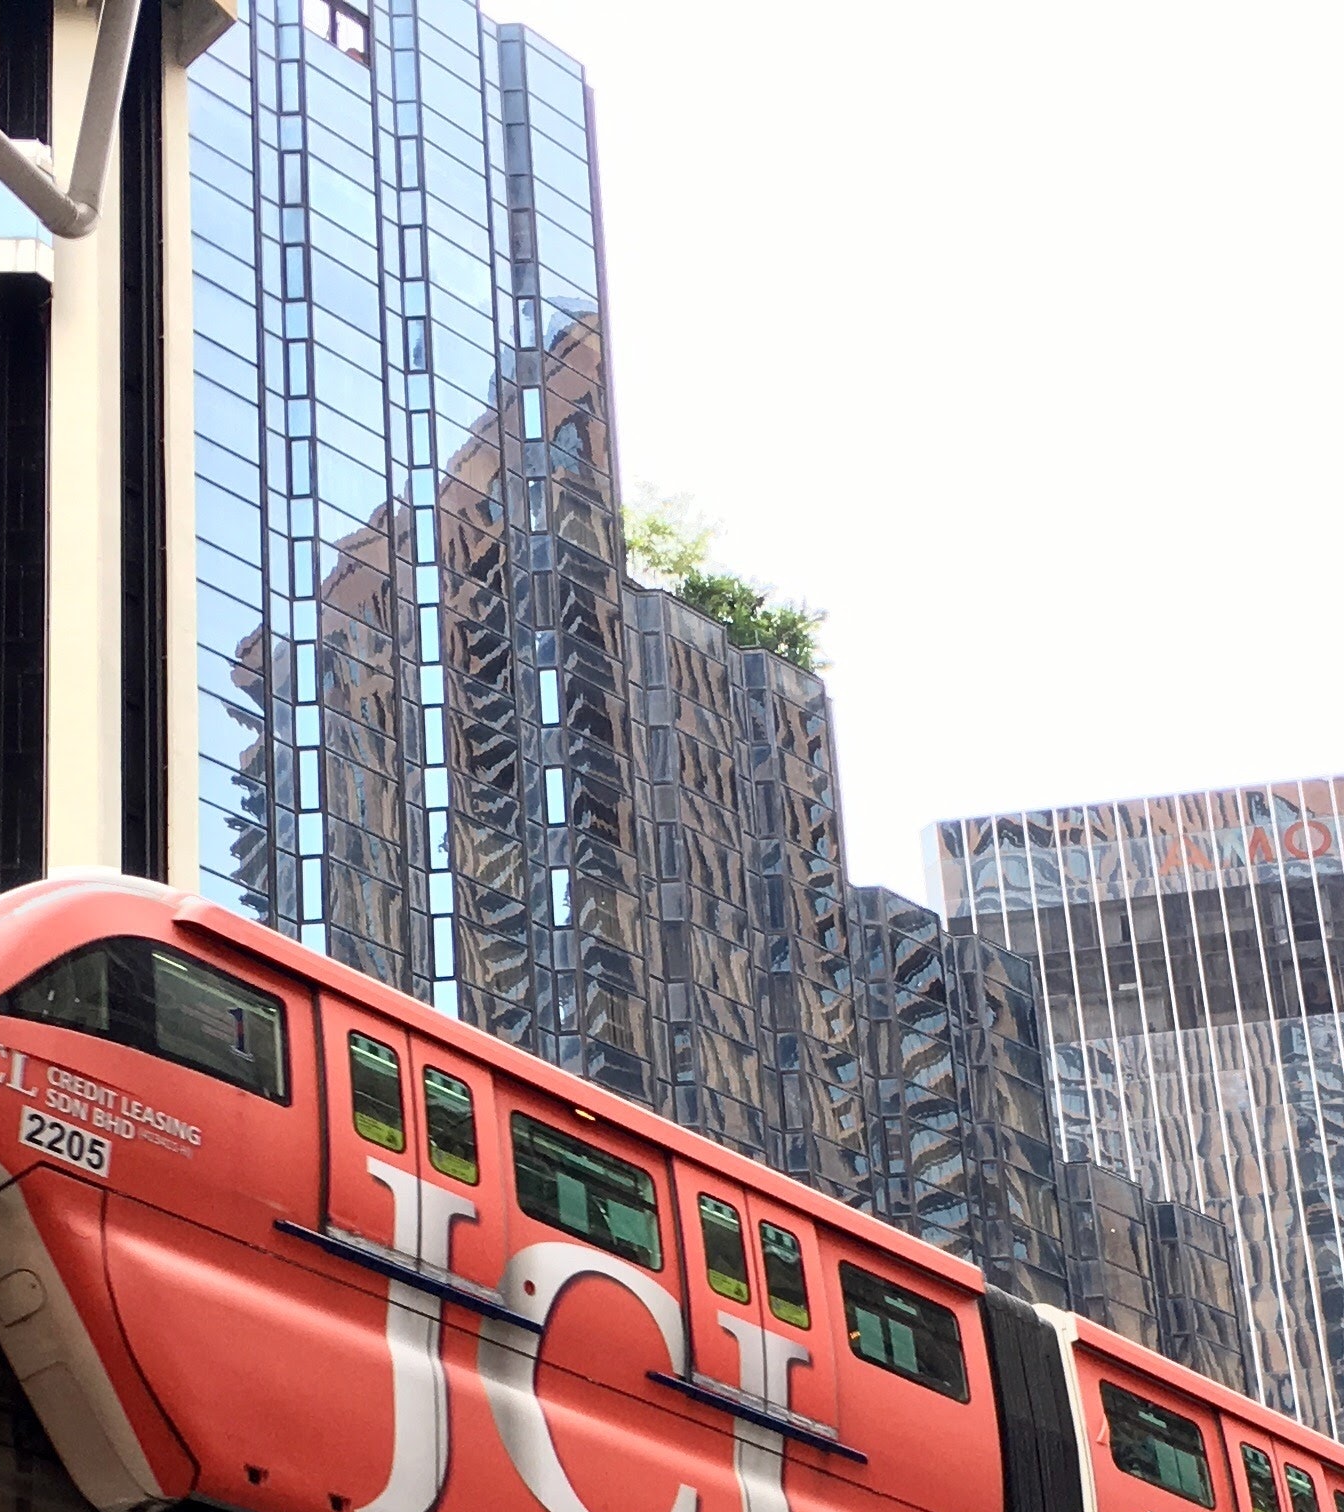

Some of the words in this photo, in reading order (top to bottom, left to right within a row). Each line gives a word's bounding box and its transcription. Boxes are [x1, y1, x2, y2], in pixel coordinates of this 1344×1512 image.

[45, 1087, 89, 1122] SDN
[92, 1107, 136, 1140] BHD
[47, 1066, 118, 1110] CREDIT
[121, 1096, 202, 1146] LEASING
[25, 1113, 105, 1170] 2205
